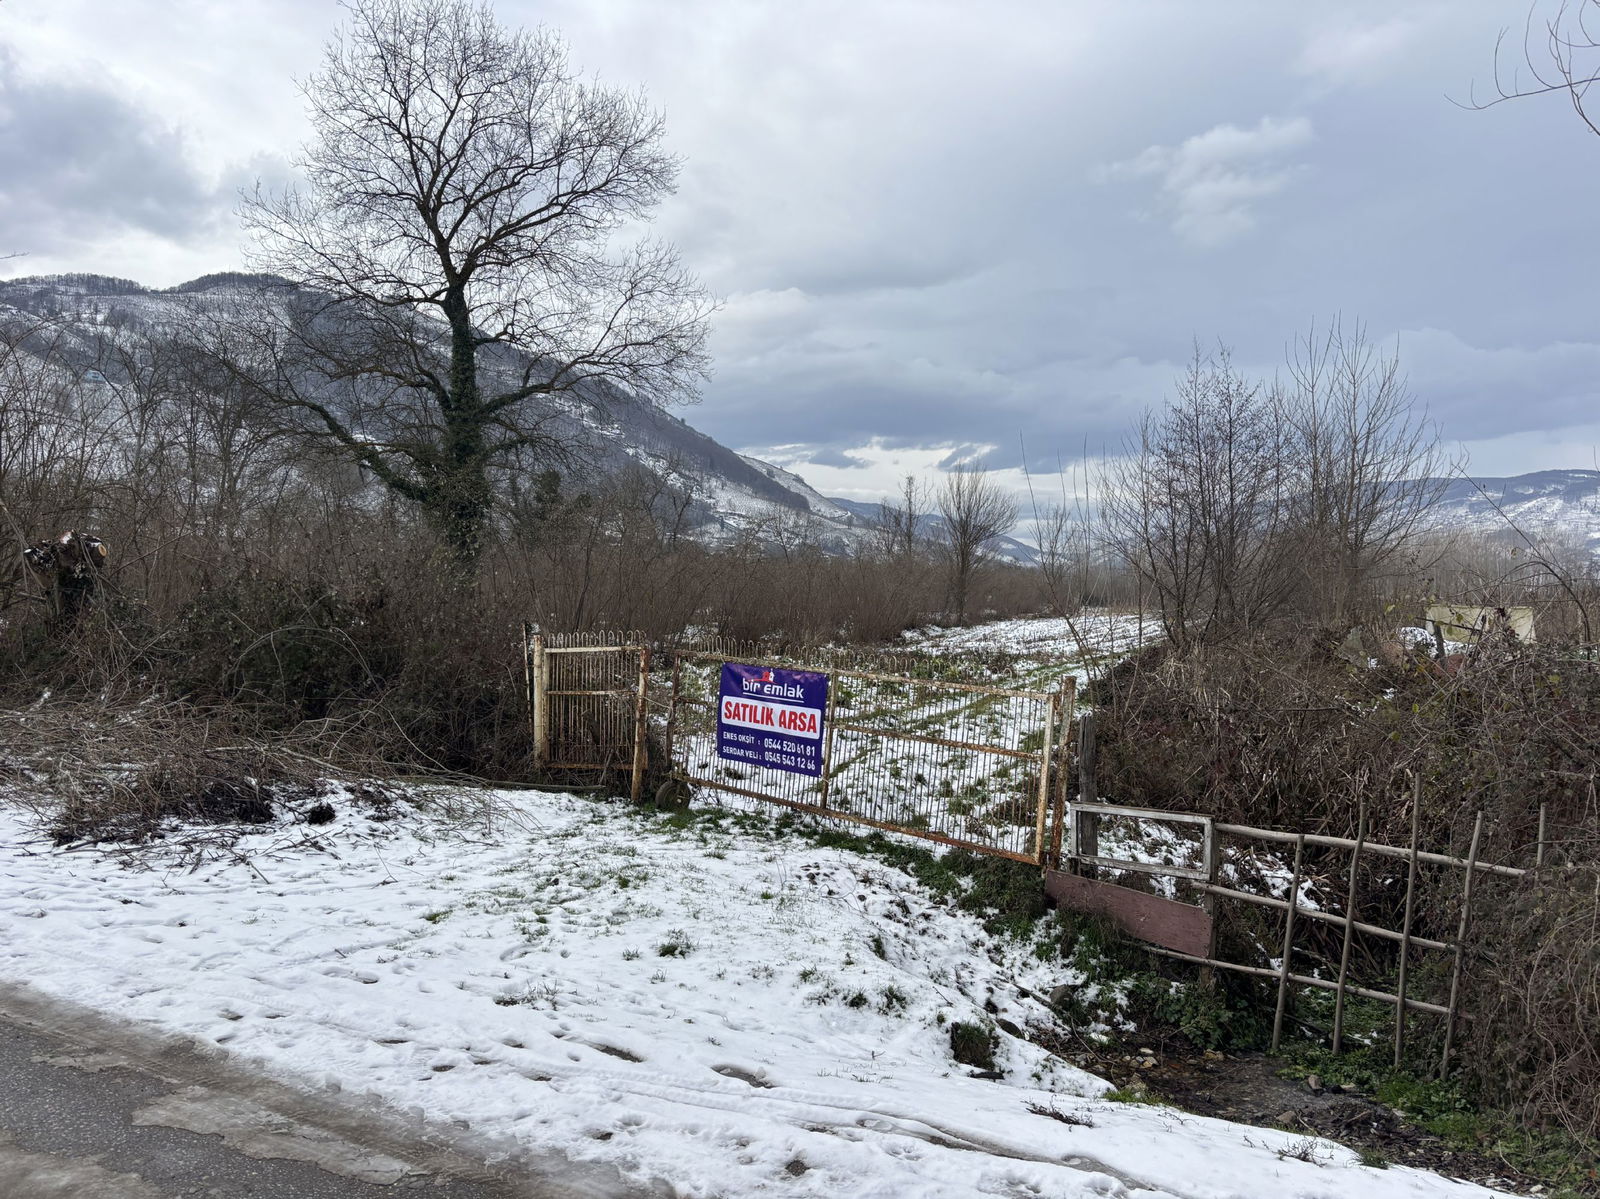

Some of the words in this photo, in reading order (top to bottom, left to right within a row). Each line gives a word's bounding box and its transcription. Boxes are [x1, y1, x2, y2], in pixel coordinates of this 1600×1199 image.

[743, 678, 760, 693] bir
[763, 683, 804, 699] emlak
[724, 701, 775, 726] SATILIK
[779, 709, 817, 733] ARSA
[723, 731, 737, 741] ENES
[764, 738, 781, 750] 0544
[783, 740, 796, 753] 520
[806, 745, 815, 757] 81
[722, 746, 745, 757] SERDAR
[764, 751, 781, 764] 0545
[782, 754, 795, 766] 543
[797, 756, 806, 769] 12
[806, 759, 816, 770] 66
